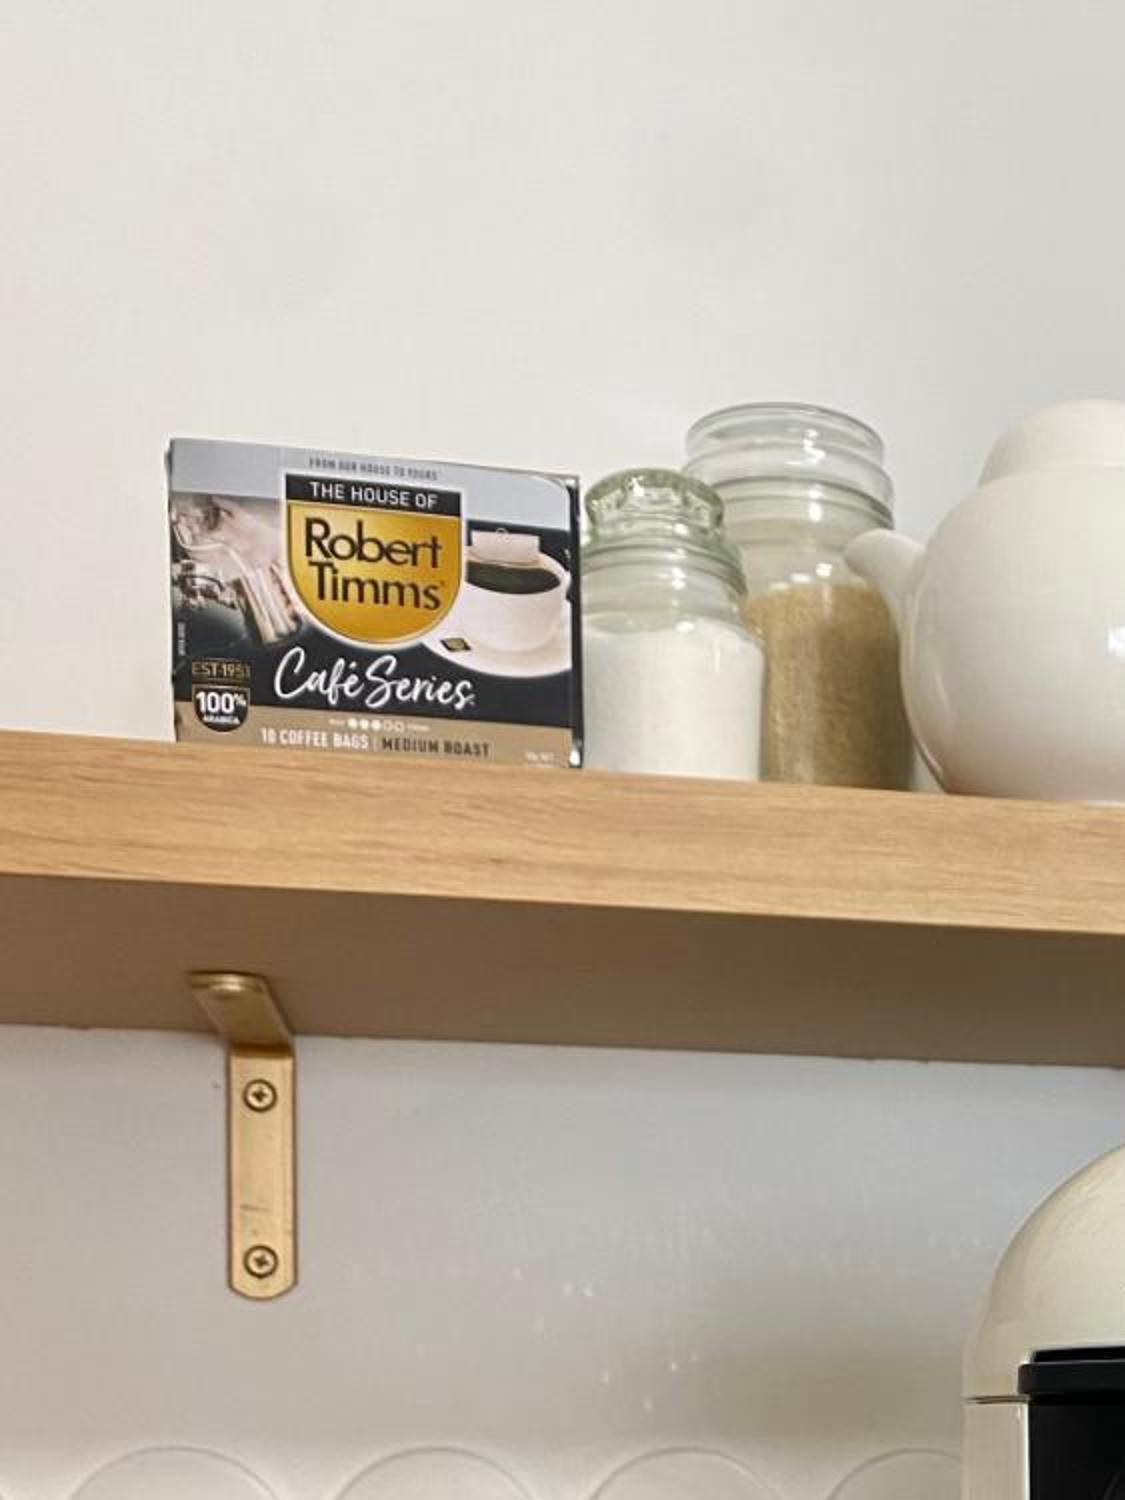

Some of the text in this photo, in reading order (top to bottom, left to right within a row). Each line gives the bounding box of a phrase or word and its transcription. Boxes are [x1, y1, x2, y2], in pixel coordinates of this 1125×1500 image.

[309, 481, 439, 509] THE HOUSE OF
[305, 517, 443, 569] Robert
[308, 560, 442, 611] Timms
[274, 647, 475, 710] Café Series
[196, 691, 247, 714] 100%
[279, 729, 328, 747] COFFEE
[333, 733, 369, 751] BAGS
[381, 736, 490, 758] MEDIUM ROAST
